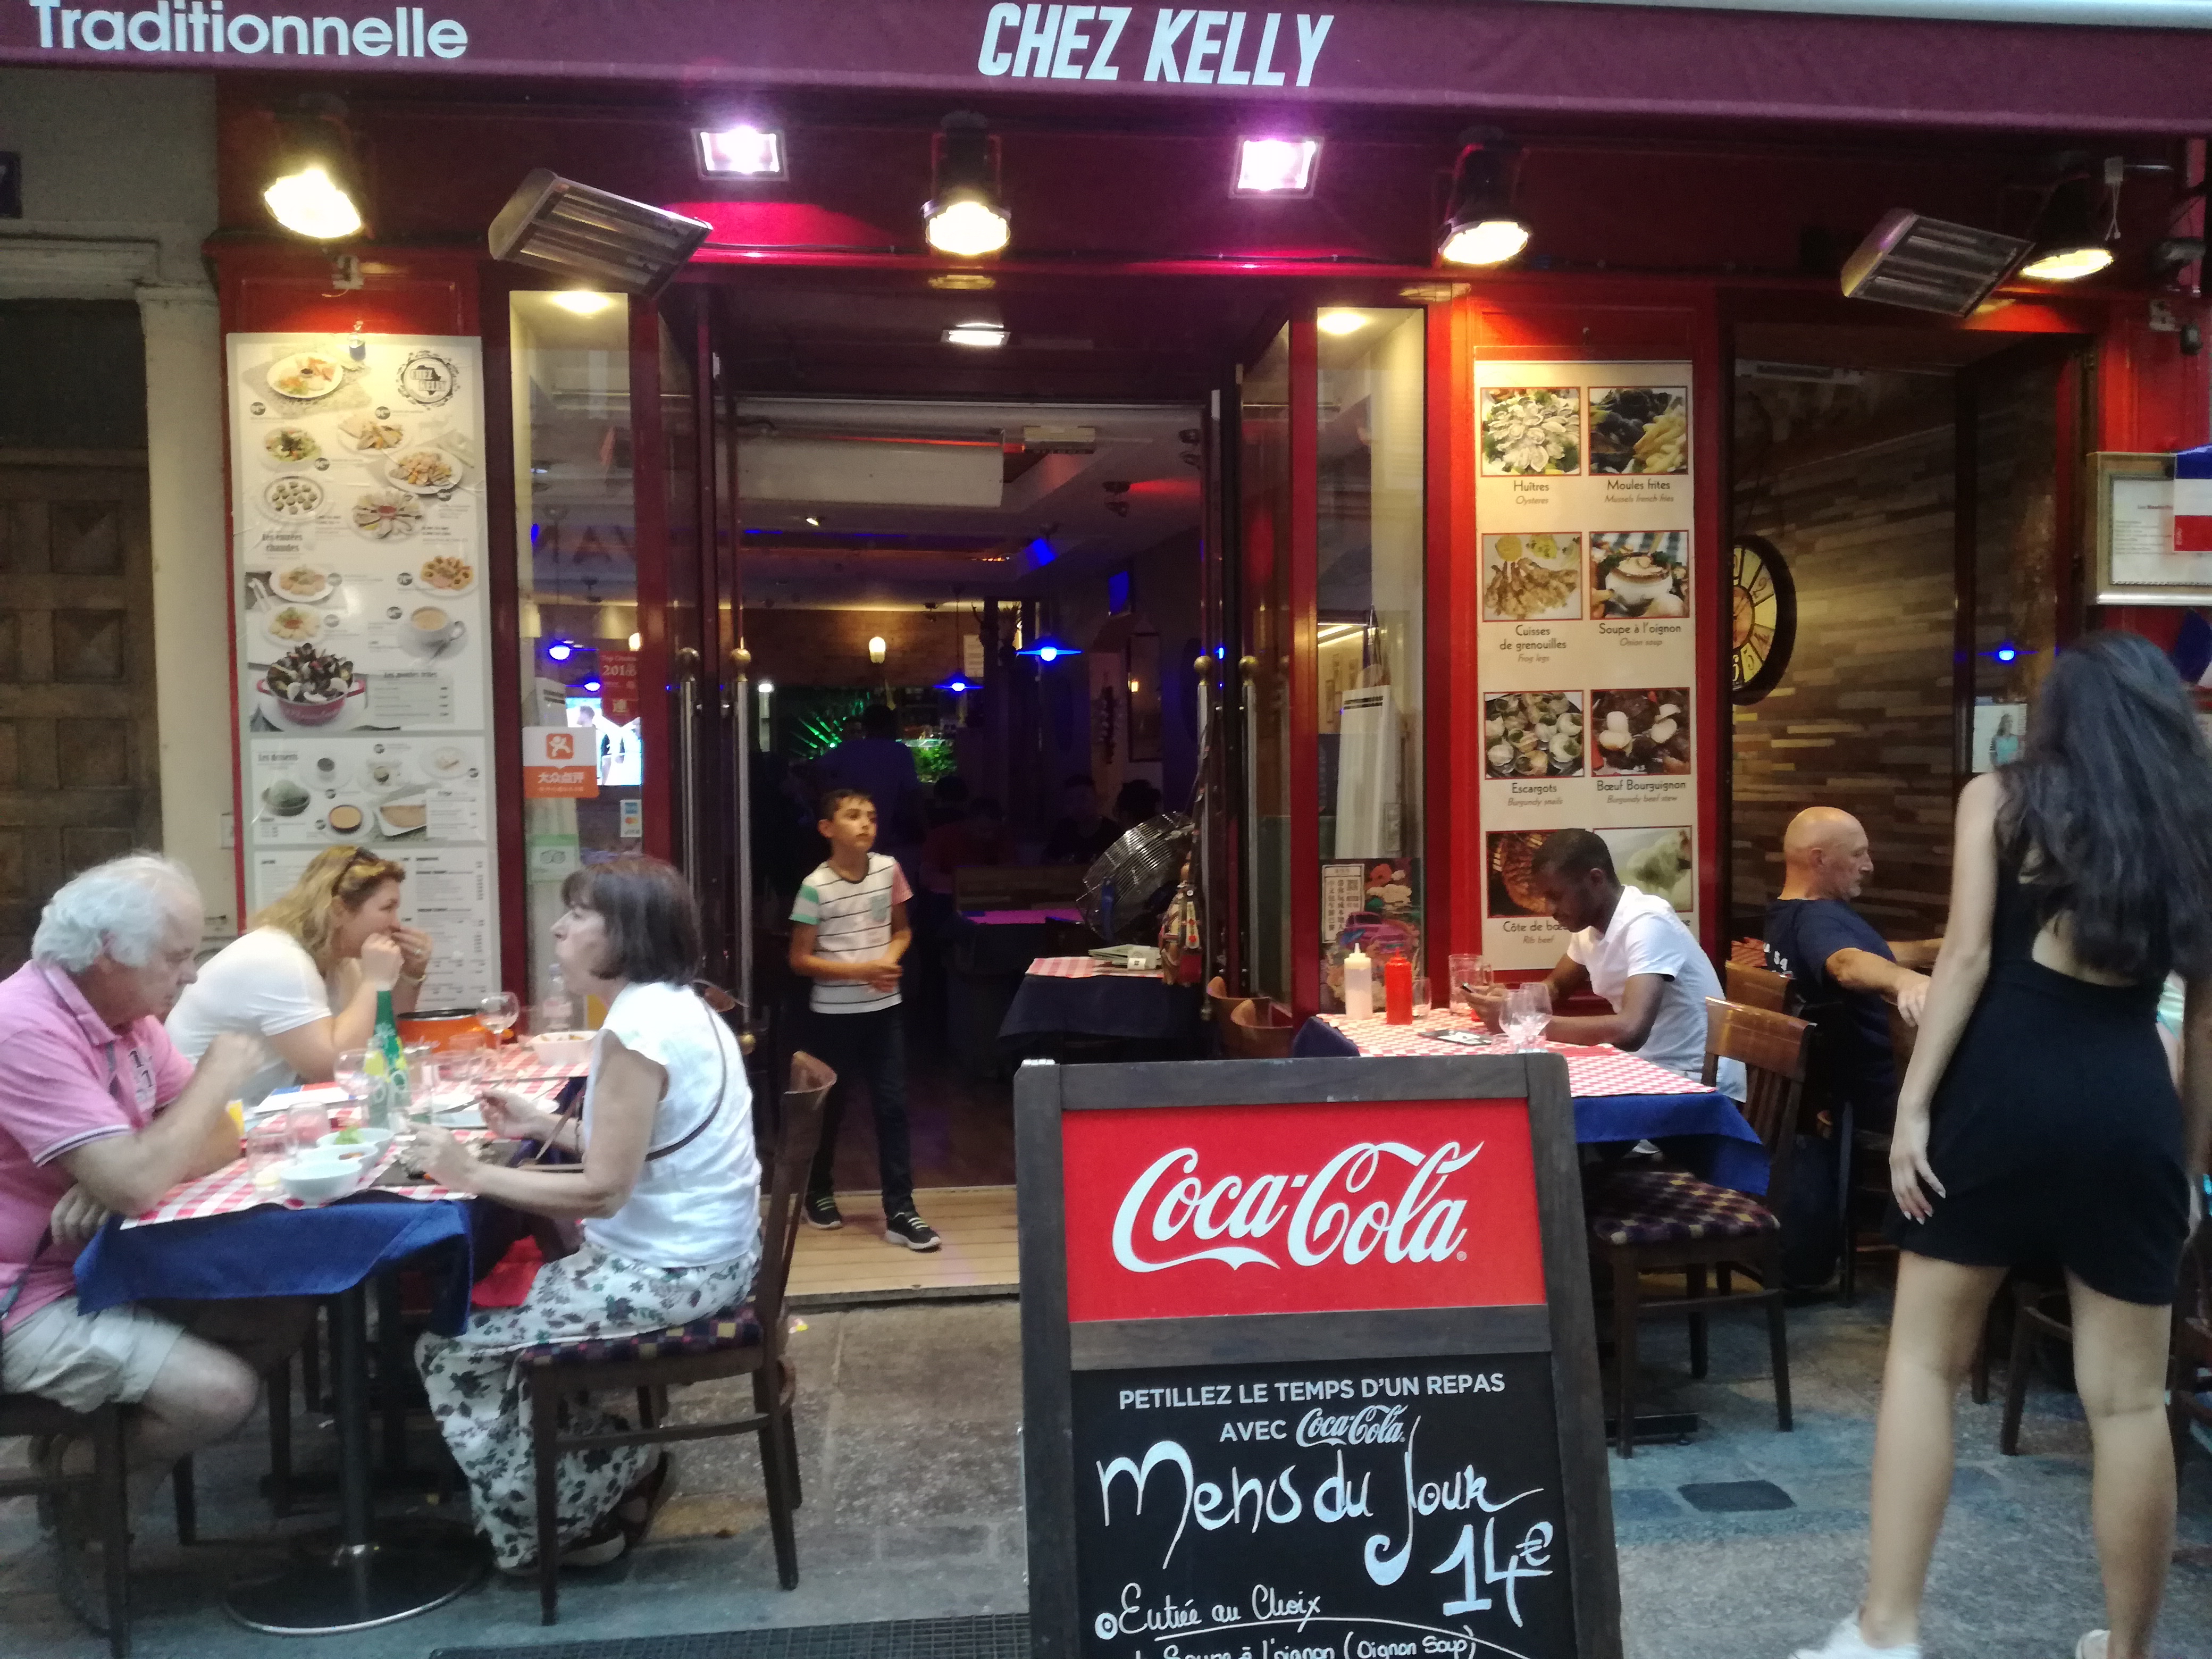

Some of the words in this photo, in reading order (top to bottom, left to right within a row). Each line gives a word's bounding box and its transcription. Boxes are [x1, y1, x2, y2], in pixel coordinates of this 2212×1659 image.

[29, 0, 468, 58] Traditionnelle
[977, 3, 1133, 80] CHEZ
[1143, 9, 1335, 87] KELLY
[1513, 481, 1549, 492] Huîtres
[1607, 479, 1644, 491] Moules
[1647, 478, 1670, 490] frites
[1515, 625, 1550, 636] Cuisses
[1599, 623, 1630, 636] Soupe
[1634, 624, 1639, 634] à
[1643, 623, 1681, 635] l'oignon
[1499, 639, 1512, 650] de
[1516, 639, 1566, 651] grenouilles
[1512, 783, 1557, 794] Escargots
[1597, 780, 1623, 791] Bœuf
[1627, 780, 1686, 792] Bourguignon
[1503, 920, 1526, 932] Côte
[1530, 920, 1543, 931] de
[1112, 1141, 1485, 1273] Coca-Cola
[1119, 1385, 1231, 1410] PETILLEZ
[1239, 1382, 1268, 1404] LE
[1273, 1379, 1355, 1402] TEMPS
[1361, 1376, 1419, 1398] D'UN
[1427, 1372, 1505, 1395] REPAS
[1220, 1420, 1286, 1443] AVEC
[1296, 1405, 1409, 1447] Coca-Cola
[1313, 1448, 1374, 1523] du
[1364, 1416, 1545, 1586] Jour
[1211, 1604, 1242, 1623] au
[1251, 1583, 1321, 1633] Choix
